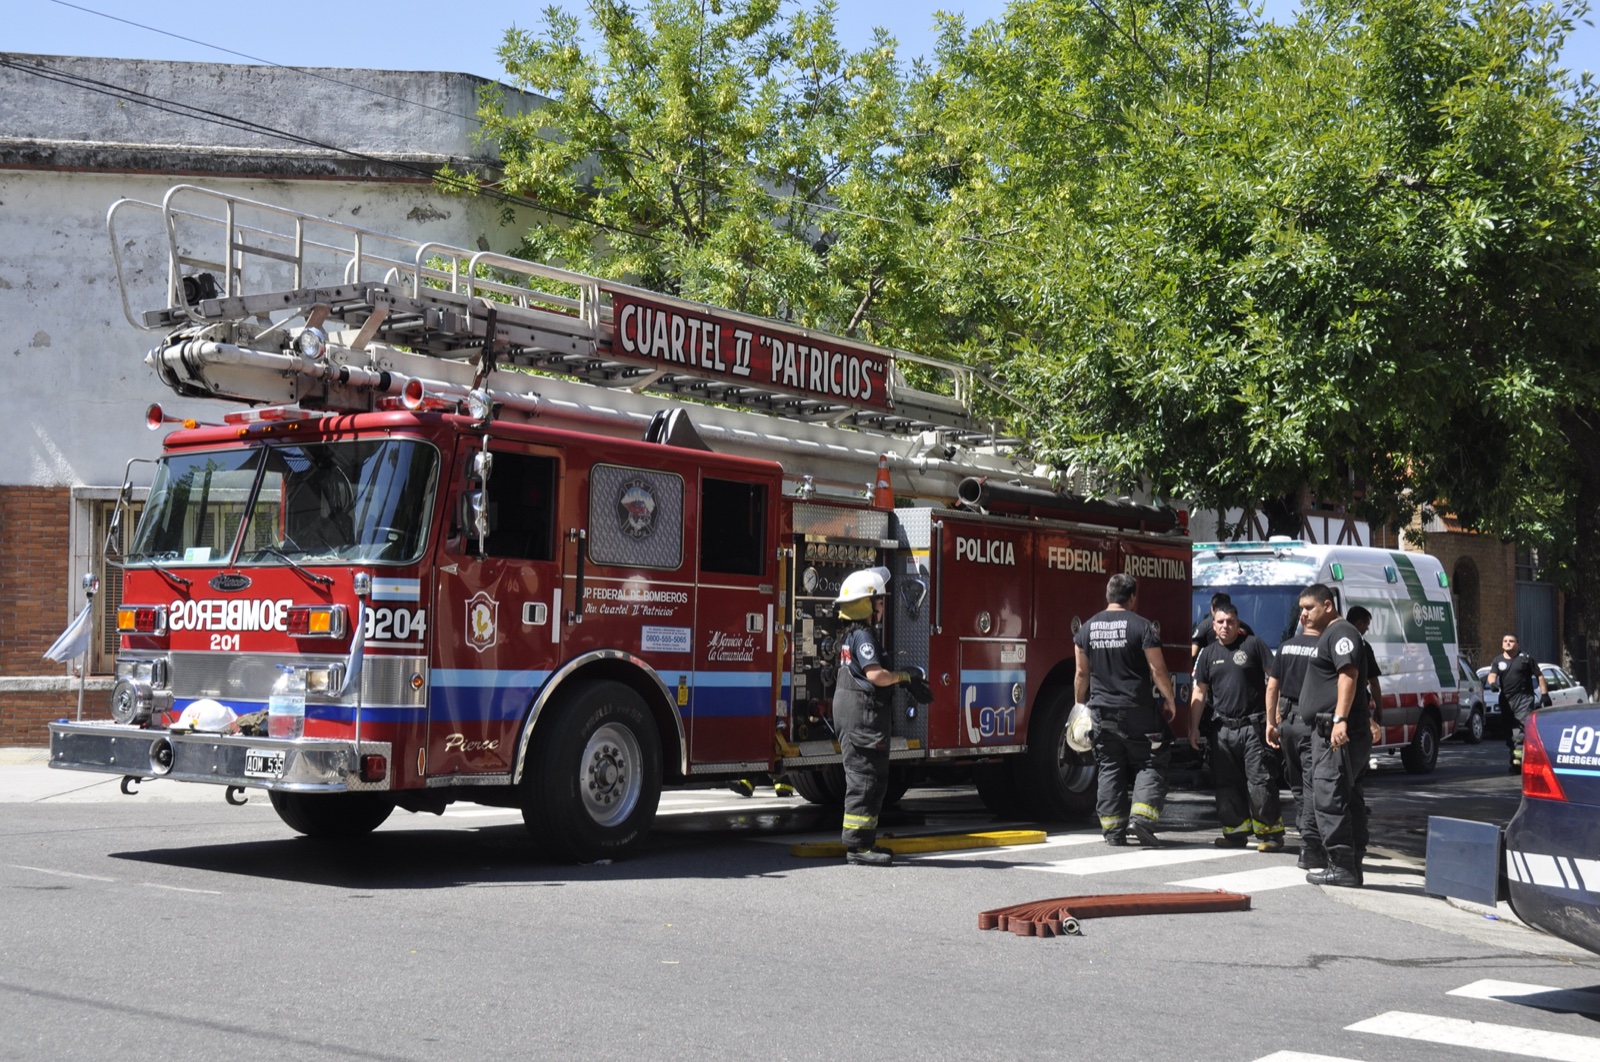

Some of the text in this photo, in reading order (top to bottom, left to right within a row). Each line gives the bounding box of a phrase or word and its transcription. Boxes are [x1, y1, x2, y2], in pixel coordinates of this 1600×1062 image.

[620, 304, 883, 401] CUARTEL II "PATRICIOS"
[956, 536, 1186, 581] POLICIA FEDERAL ARGENTINA
[593, 587, 627, 600] FEDERAL
[630, 590, 641, 600] DE
[643, 590, 688, 604] BOMBEROS
[599, 603, 630, 615] Cuartel
[1422, 605, 1446, 622] SAME
[364, 607, 427, 640] 9204
[210, 634, 240, 650] 201
[717, 633, 743, 648] Servicio
[744, 634, 754, 648] de
[980, 706, 1016, 738] 911
[445, 732, 499, 752] Pierce
